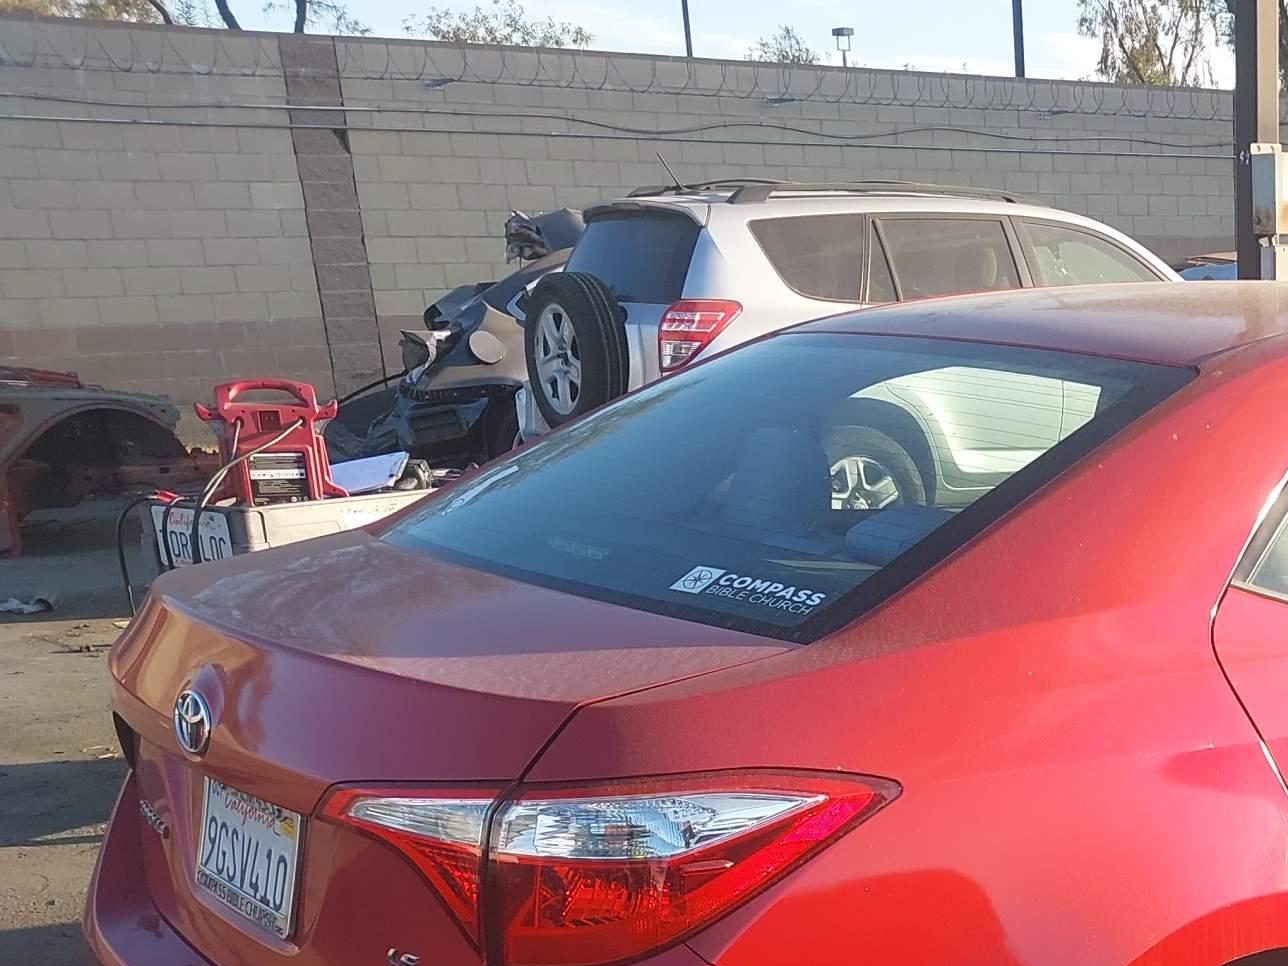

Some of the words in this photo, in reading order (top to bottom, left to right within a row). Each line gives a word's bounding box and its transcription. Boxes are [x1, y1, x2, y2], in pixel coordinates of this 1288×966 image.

[705, 585, 748, 601] BIBLE
[749, 593, 813, 616] CHURCH
[718, 574, 827, 606] COMPASS
[202, 815, 287, 913] 9GSV410
